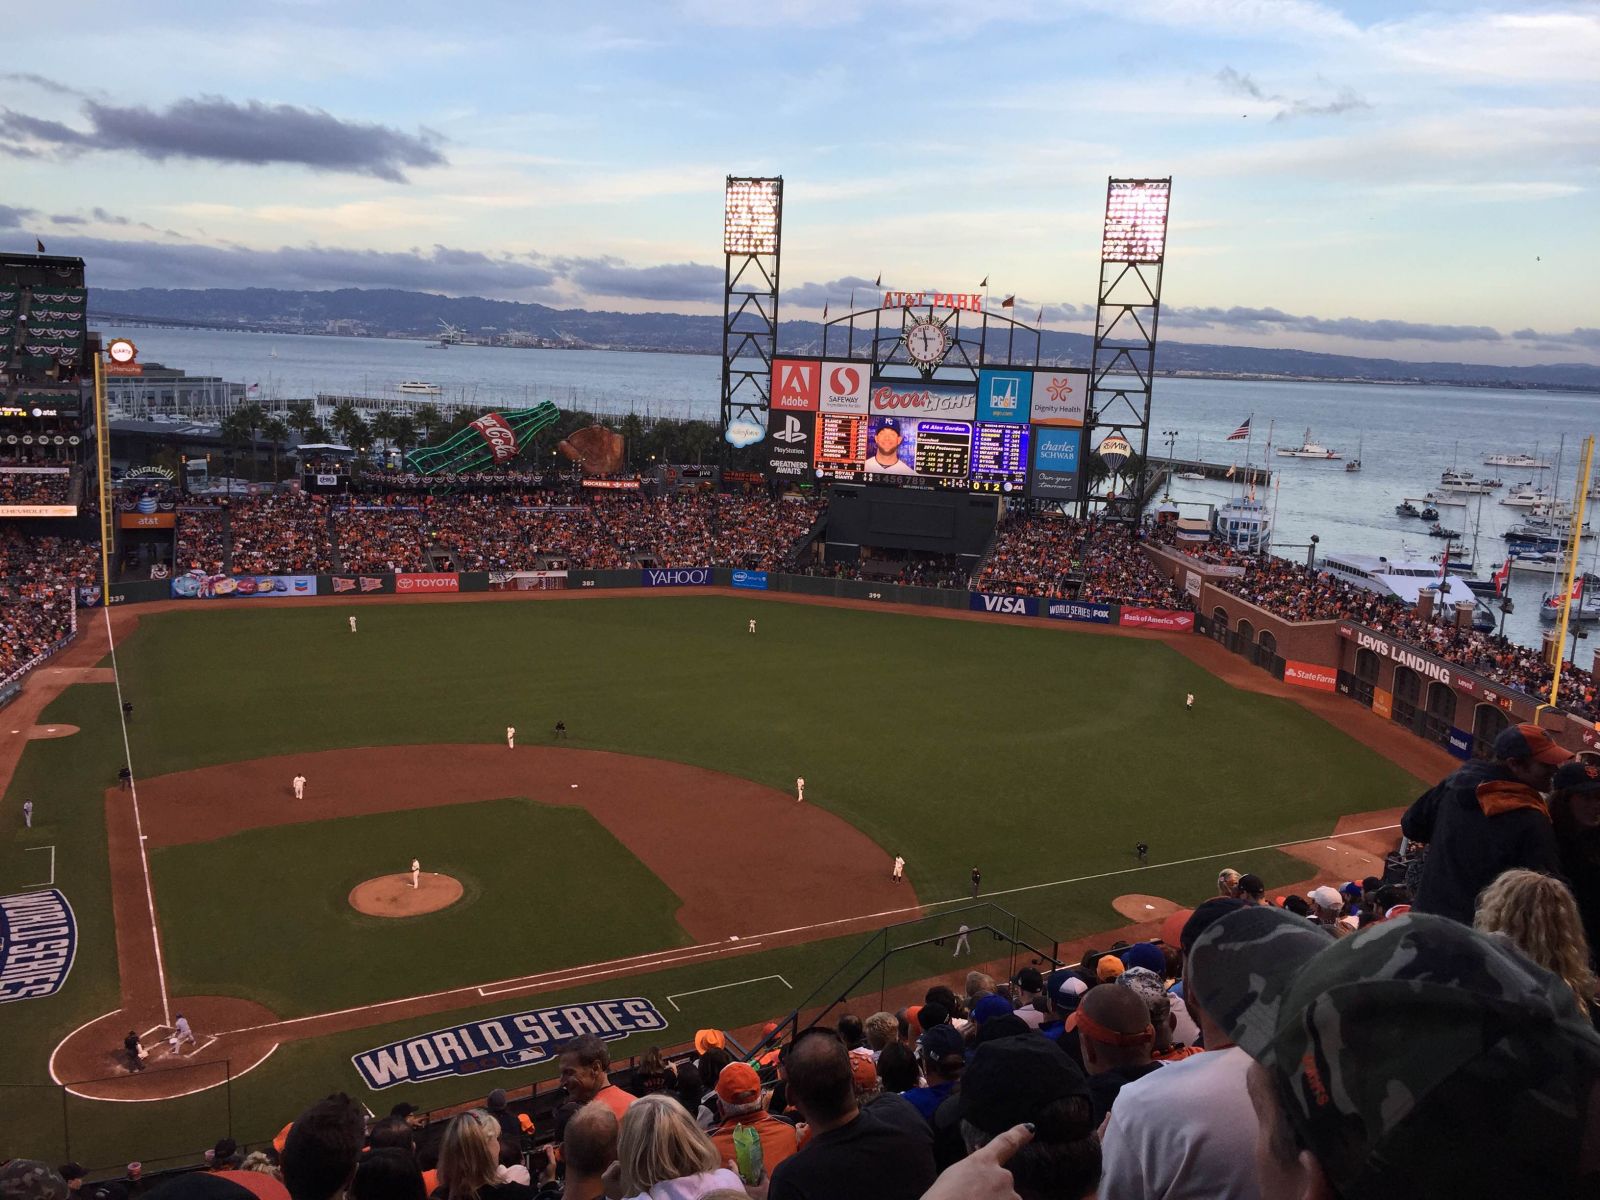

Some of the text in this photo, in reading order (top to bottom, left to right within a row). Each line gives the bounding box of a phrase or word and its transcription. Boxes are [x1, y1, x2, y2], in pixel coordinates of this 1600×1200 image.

[882, 292, 982, 313] AT&T PARK
[907, 356, 944, 371] GIANTS
[781, 395, 808, 407] Adobe
[828, 395, 859, 404] SAFEWAY
[873, 386, 975, 412] Coors LIGHT
[992, 395, 1017, 408] PG&E
[1034, 404, 1081, 414] Dignity Health
[774, 446, 804, 455] PlayStation
[1041, 440, 1075, 453] charles
[1040, 450, 1074, 460] SCHWAB
[770, 459, 808, 469] GREATNESS
[125, 465, 176, 481] Ghirardelli
[973, 482, 980, 490] 0
[983, 483, 989, 491] 1
[993, 483, 1000, 492] 2
[137, 517, 159, 525] at&t
[415, 578, 458, 588] TOYOTA
[649, 569, 708, 586] YAHOO!
[981, 594, 1026, 614] VISA
[1049, 604, 1109, 618] WORLD SERIES FOX
[1124, 613, 1174, 625] Bank of America
[1391, 646, 1450, 684] LANDING
[360, 1001, 660, 1086] WORLD SERIES
